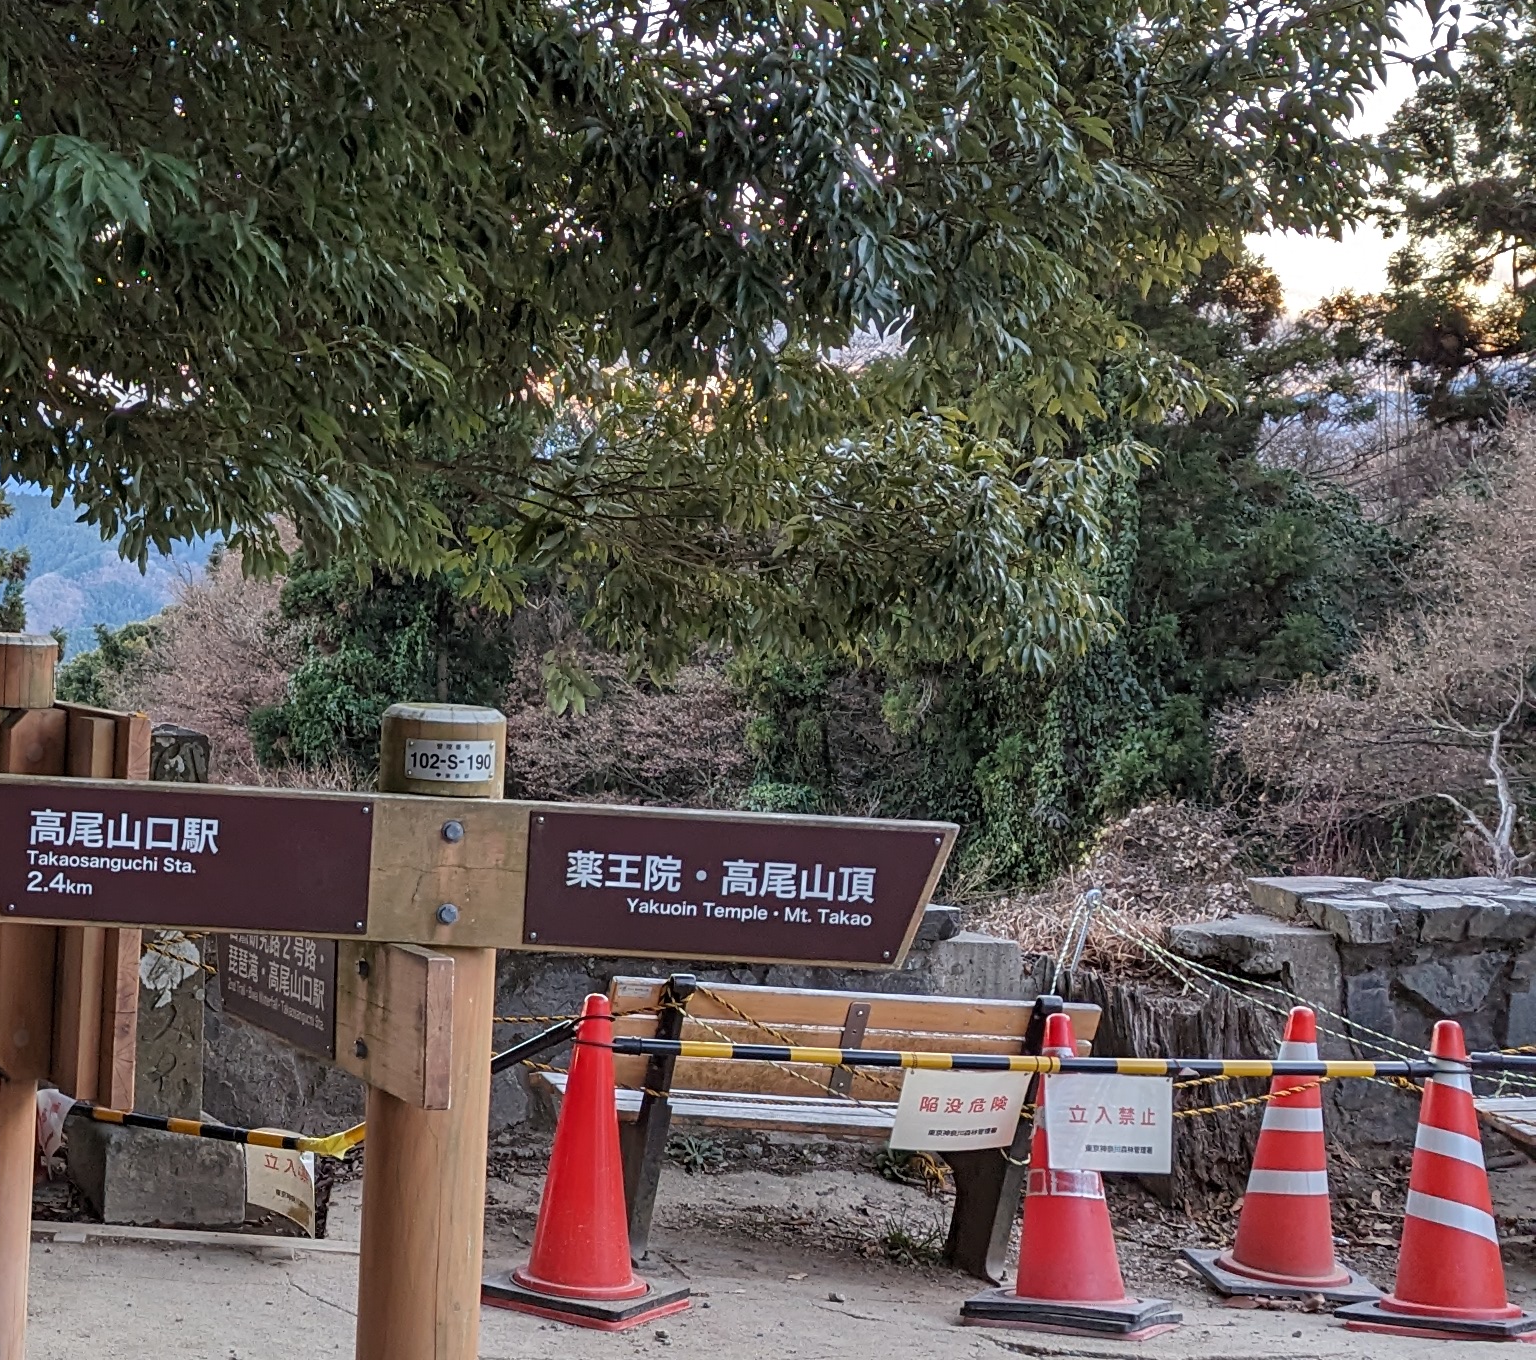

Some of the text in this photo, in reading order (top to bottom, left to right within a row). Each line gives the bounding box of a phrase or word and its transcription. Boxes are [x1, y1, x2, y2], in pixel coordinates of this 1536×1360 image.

[410, 751, 492, 771] 102-S-190
[29, 808, 219, 854] 高尾山口駅
[26, 849, 197, 873] Takaosanguchi Sta.
[26, 870, 93, 895] 2.4km
[626, 897, 697, 917] Yakuoin
[817, 908, 872, 927] Takao
[919, 1095, 1009, 1114] 陥没危険
[1068, 1104, 1156, 1126] 立入禁止
